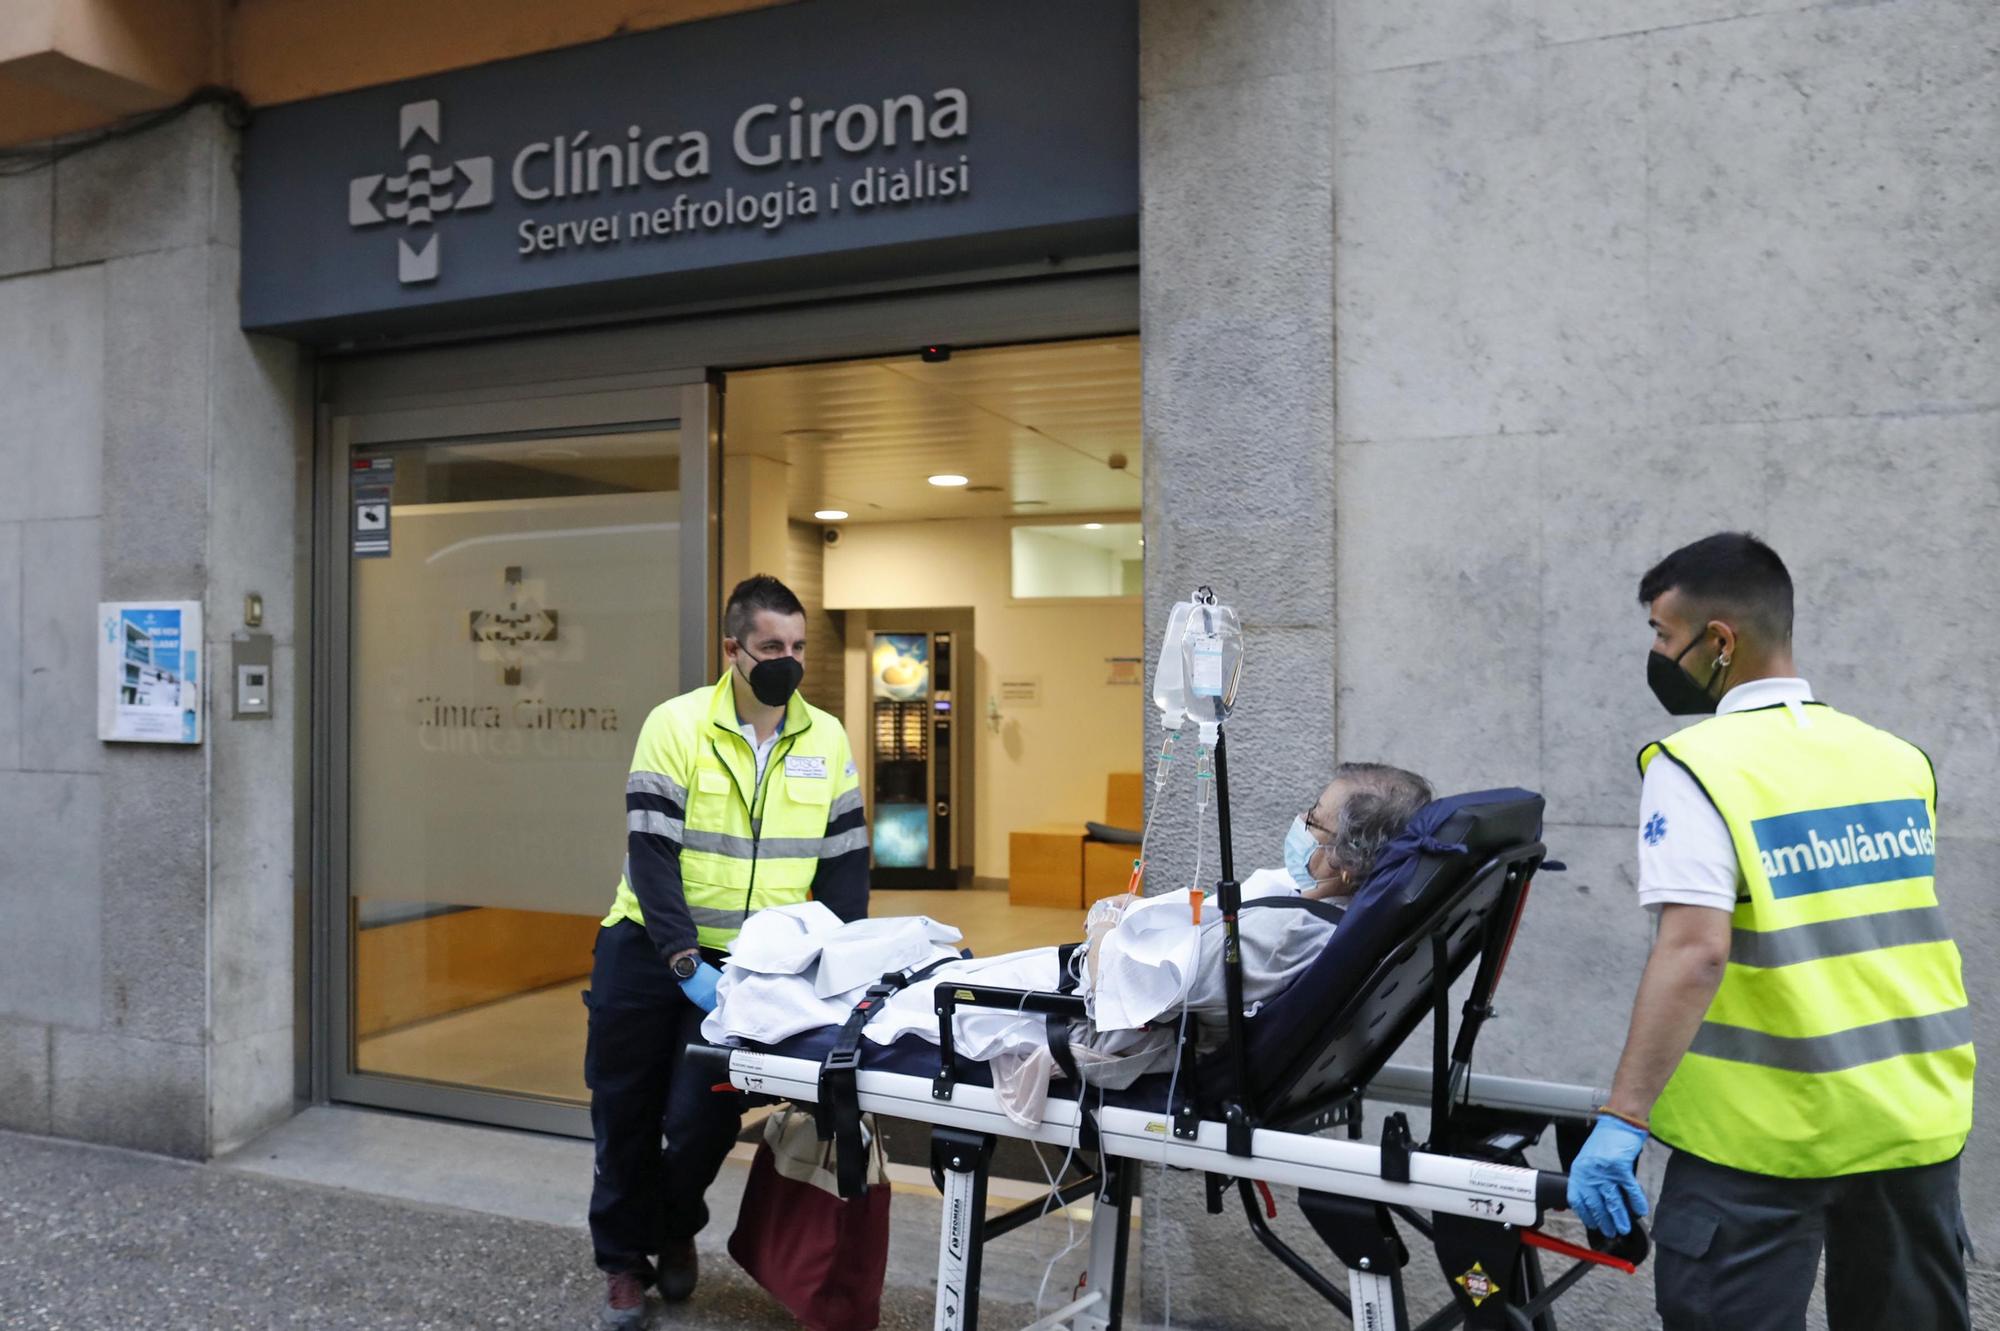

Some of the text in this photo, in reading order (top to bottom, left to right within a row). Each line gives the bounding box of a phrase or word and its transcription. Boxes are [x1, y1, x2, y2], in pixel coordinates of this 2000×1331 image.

[511, 87, 968, 200] Clínica Girona
[518, 155, 969, 254] Servei nefrologia i diàlisi
[1760, 816, 1936, 878] ambulàncies
